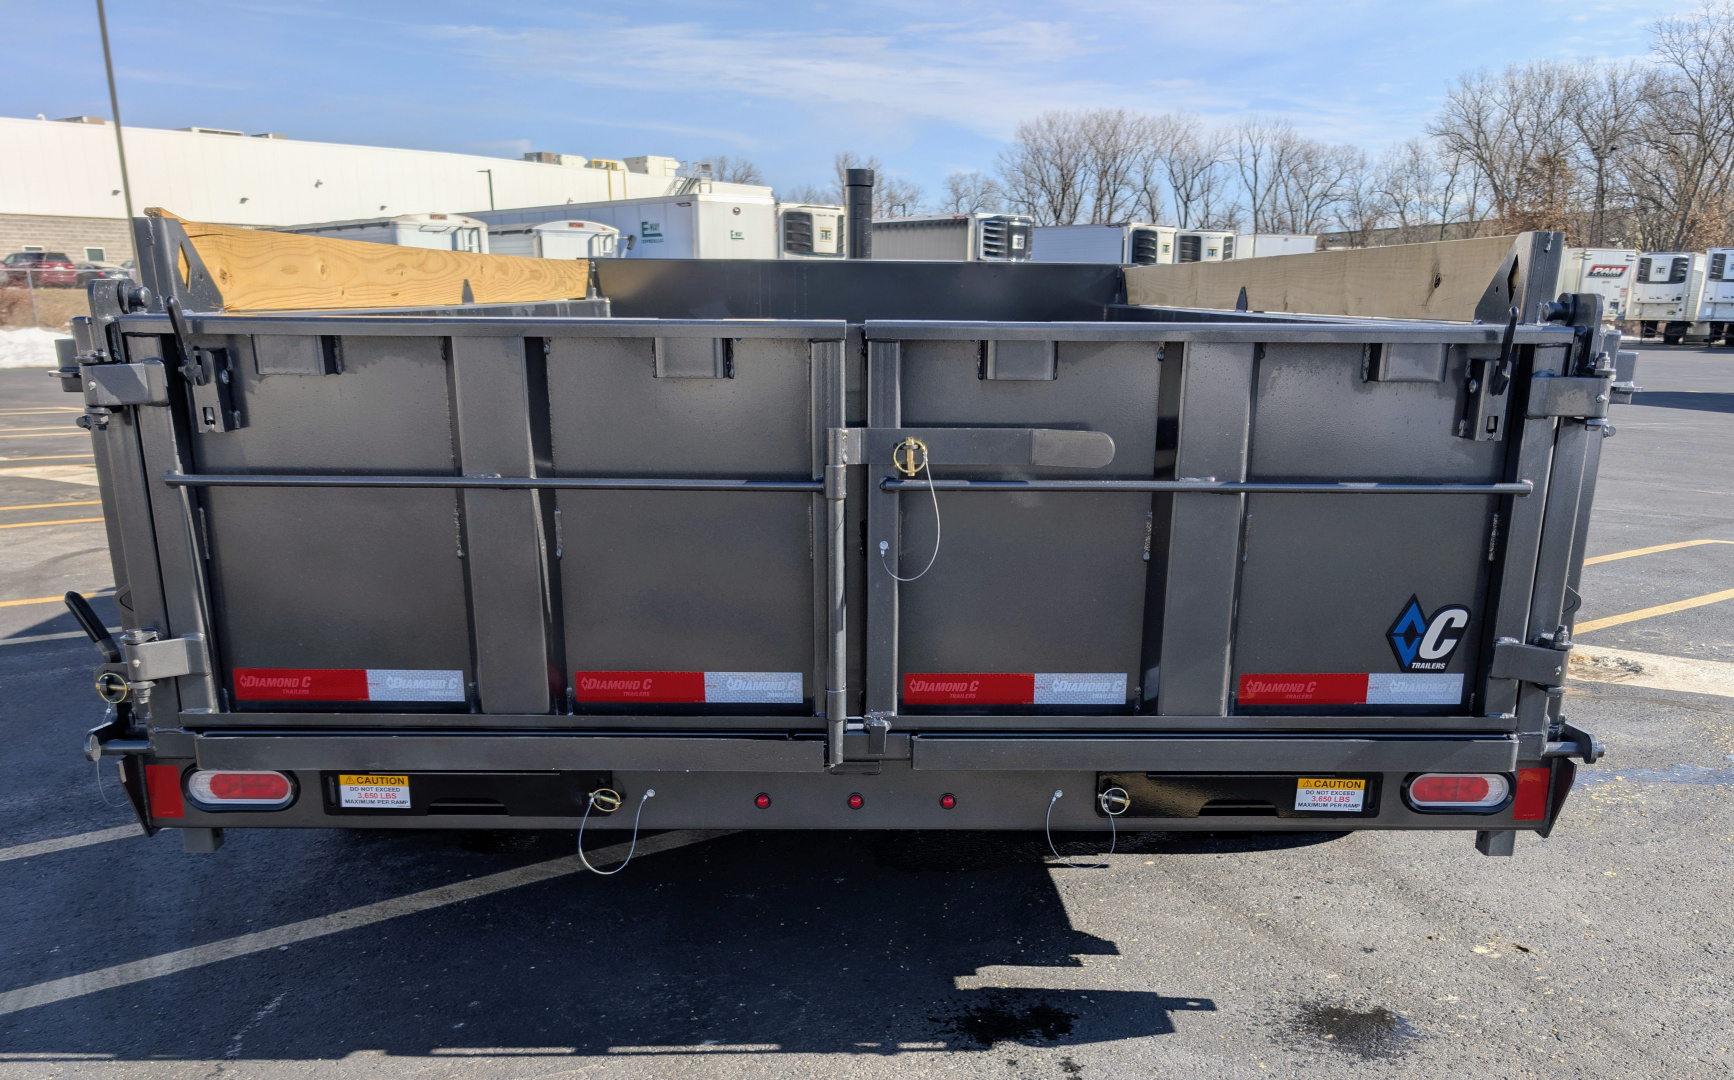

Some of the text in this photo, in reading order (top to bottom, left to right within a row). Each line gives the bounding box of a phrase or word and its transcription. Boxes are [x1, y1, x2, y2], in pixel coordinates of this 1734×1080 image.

[1592, 267, 1623, 275] PAM
[1418, 608, 1468, 660] C
[1411, 662, 1446, 670] TRAILERS
[246, 675, 312, 688] DIAMOND C
[393, 677, 459, 689] DIAMOND C
[587, 678, 653, 690] DIAMOND C
[733, 679, 797, 691] DIAMOND C
[916, 680, 980, 692] DIAMOND C
[1057, 680, 1123, 692] DIAMOND C
[1252, 681, 1317, 693] DIAMOND C
[1396, 681, 1448, 693] DIAMOND
[356, 776, 405, 785] CAUTION
[1313, 780, 1362, 789] CAUTION
[357, 792, 379, 800] 3,650
[1311, 795, 1332, 803] 3,650
